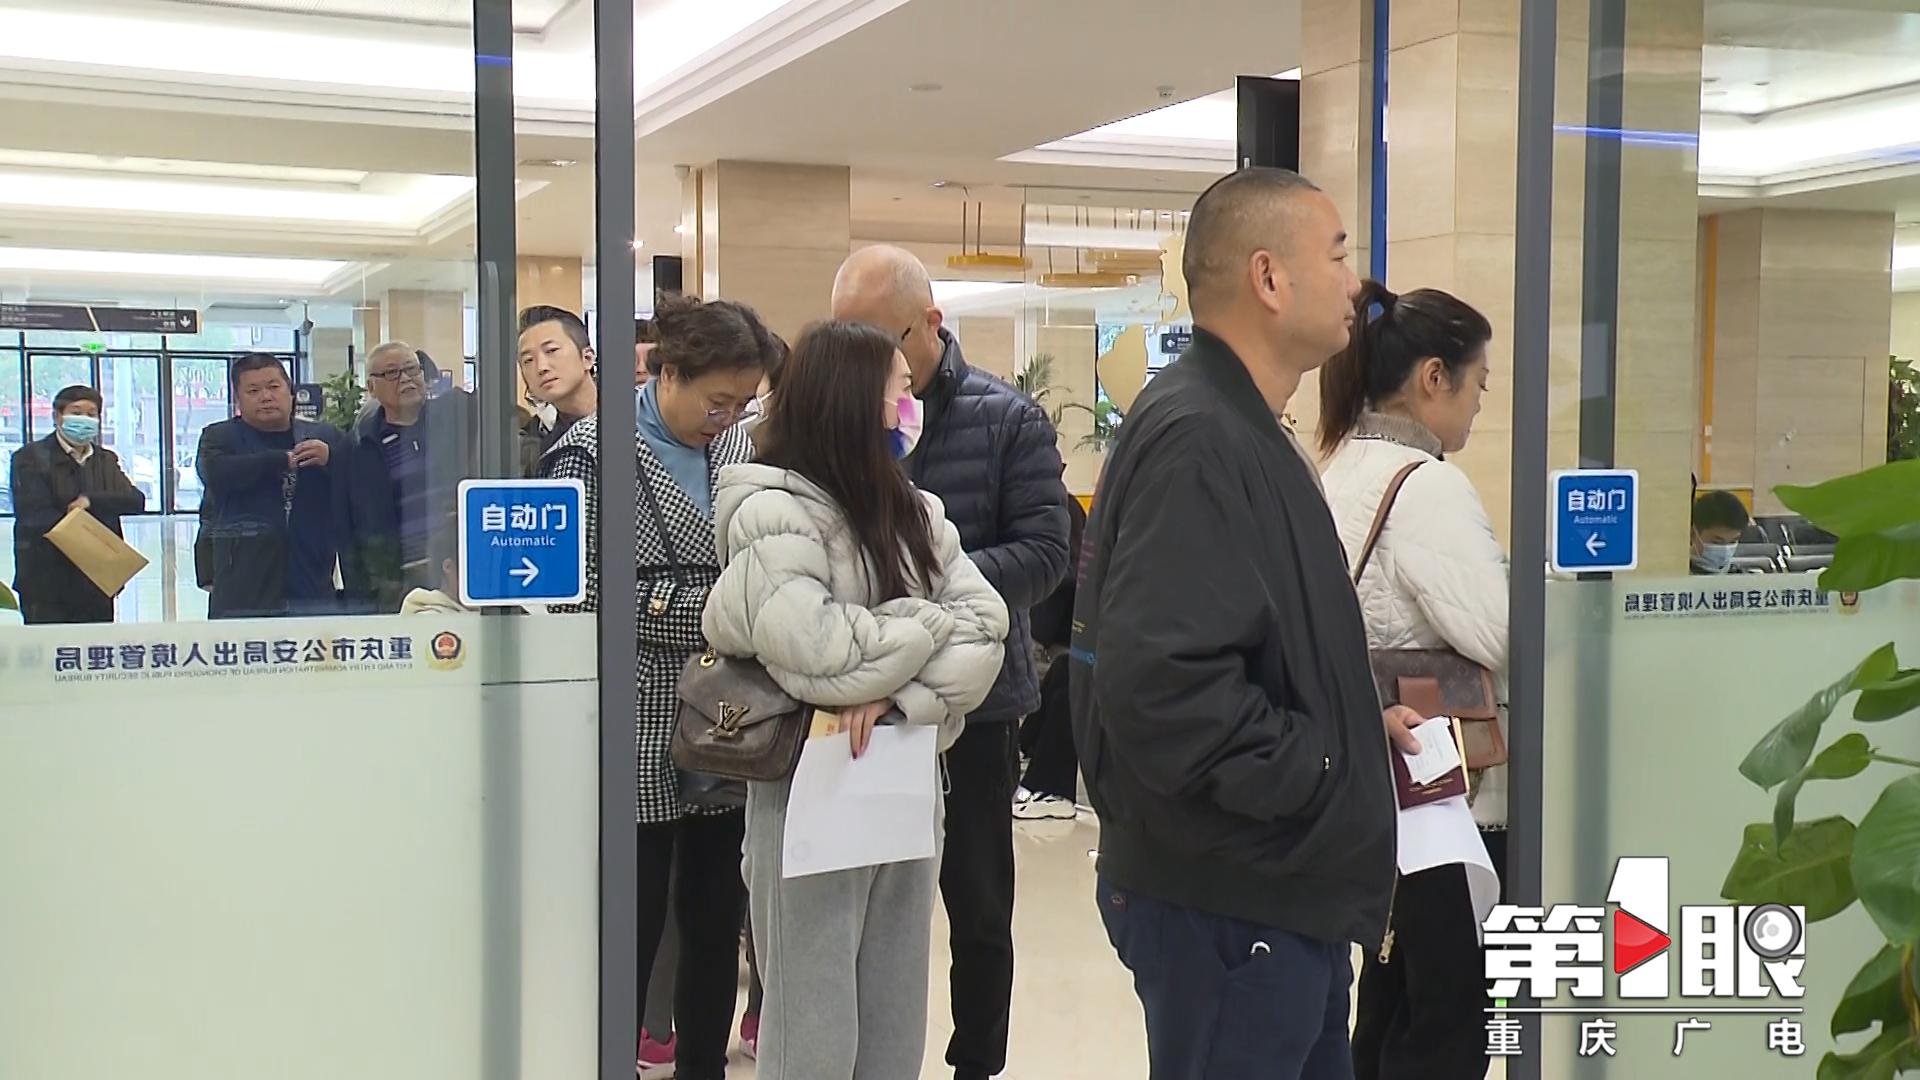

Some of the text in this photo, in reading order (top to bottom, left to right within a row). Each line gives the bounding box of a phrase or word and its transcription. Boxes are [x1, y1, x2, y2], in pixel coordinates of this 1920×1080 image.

[1567, 488, 1626, 512] 自动门
[482, 503, 567, 531] 自动门
[490, 535, 557, 546] Automatic
